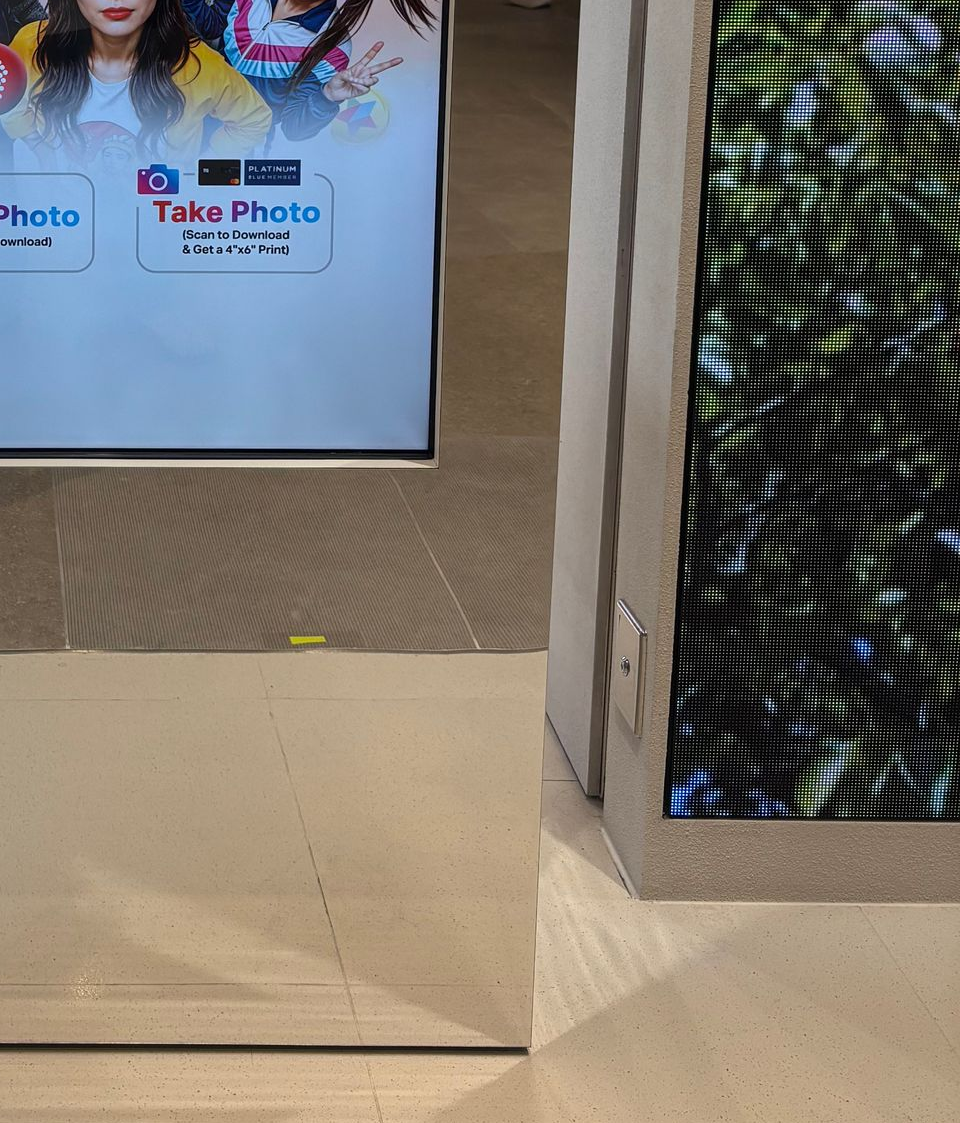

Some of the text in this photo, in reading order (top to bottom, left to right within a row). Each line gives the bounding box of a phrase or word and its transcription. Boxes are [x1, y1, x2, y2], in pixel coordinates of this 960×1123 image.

[248, 165, 297, 173] PLATINUM
[153, 200, 321, 224] Take Photo
[182, 229, 290, 241] (Scan to Download
[182, 244, 191, 254] &
[193, 244, 213, 254] Get
[216, 246, 223, 254] a
[258, 244, 290, 256] Print)
